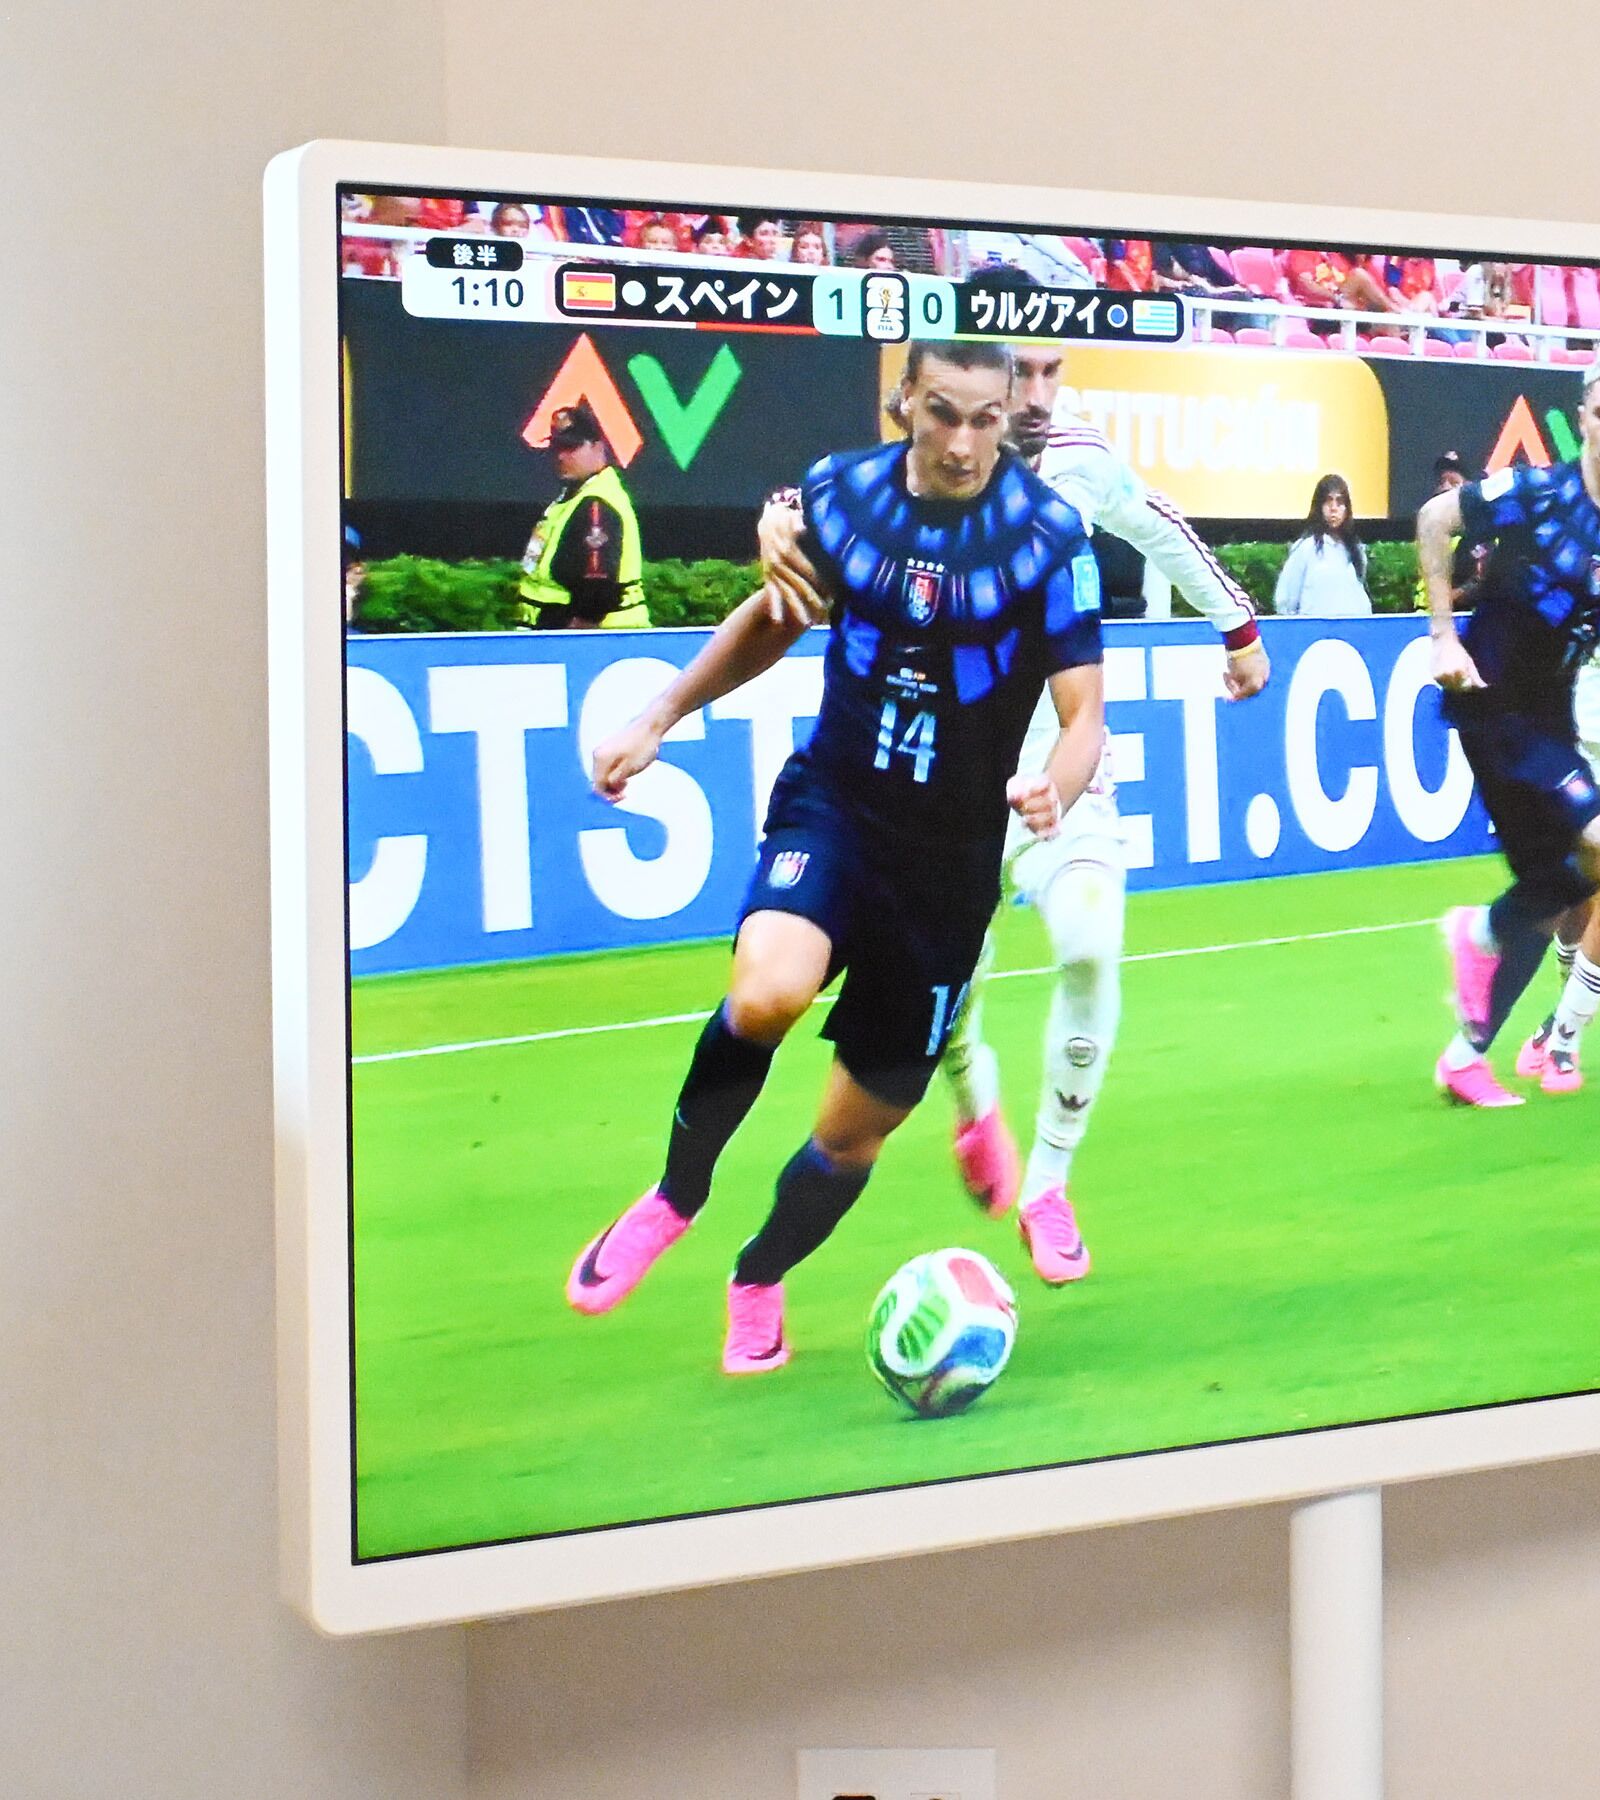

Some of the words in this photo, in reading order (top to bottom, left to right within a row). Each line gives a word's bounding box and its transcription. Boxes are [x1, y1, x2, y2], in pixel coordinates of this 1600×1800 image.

[452, 243, 498, 266] 後半
[451, 275, 524, 308] 1:10
[654, 275, 798, 318] スペイン
[828, 288, 844, 320] 1
[922, 292, 943, 324] 0
[970, 289, 1101, 335] ウルグアイ
[873, 700, 937, 783] 14
